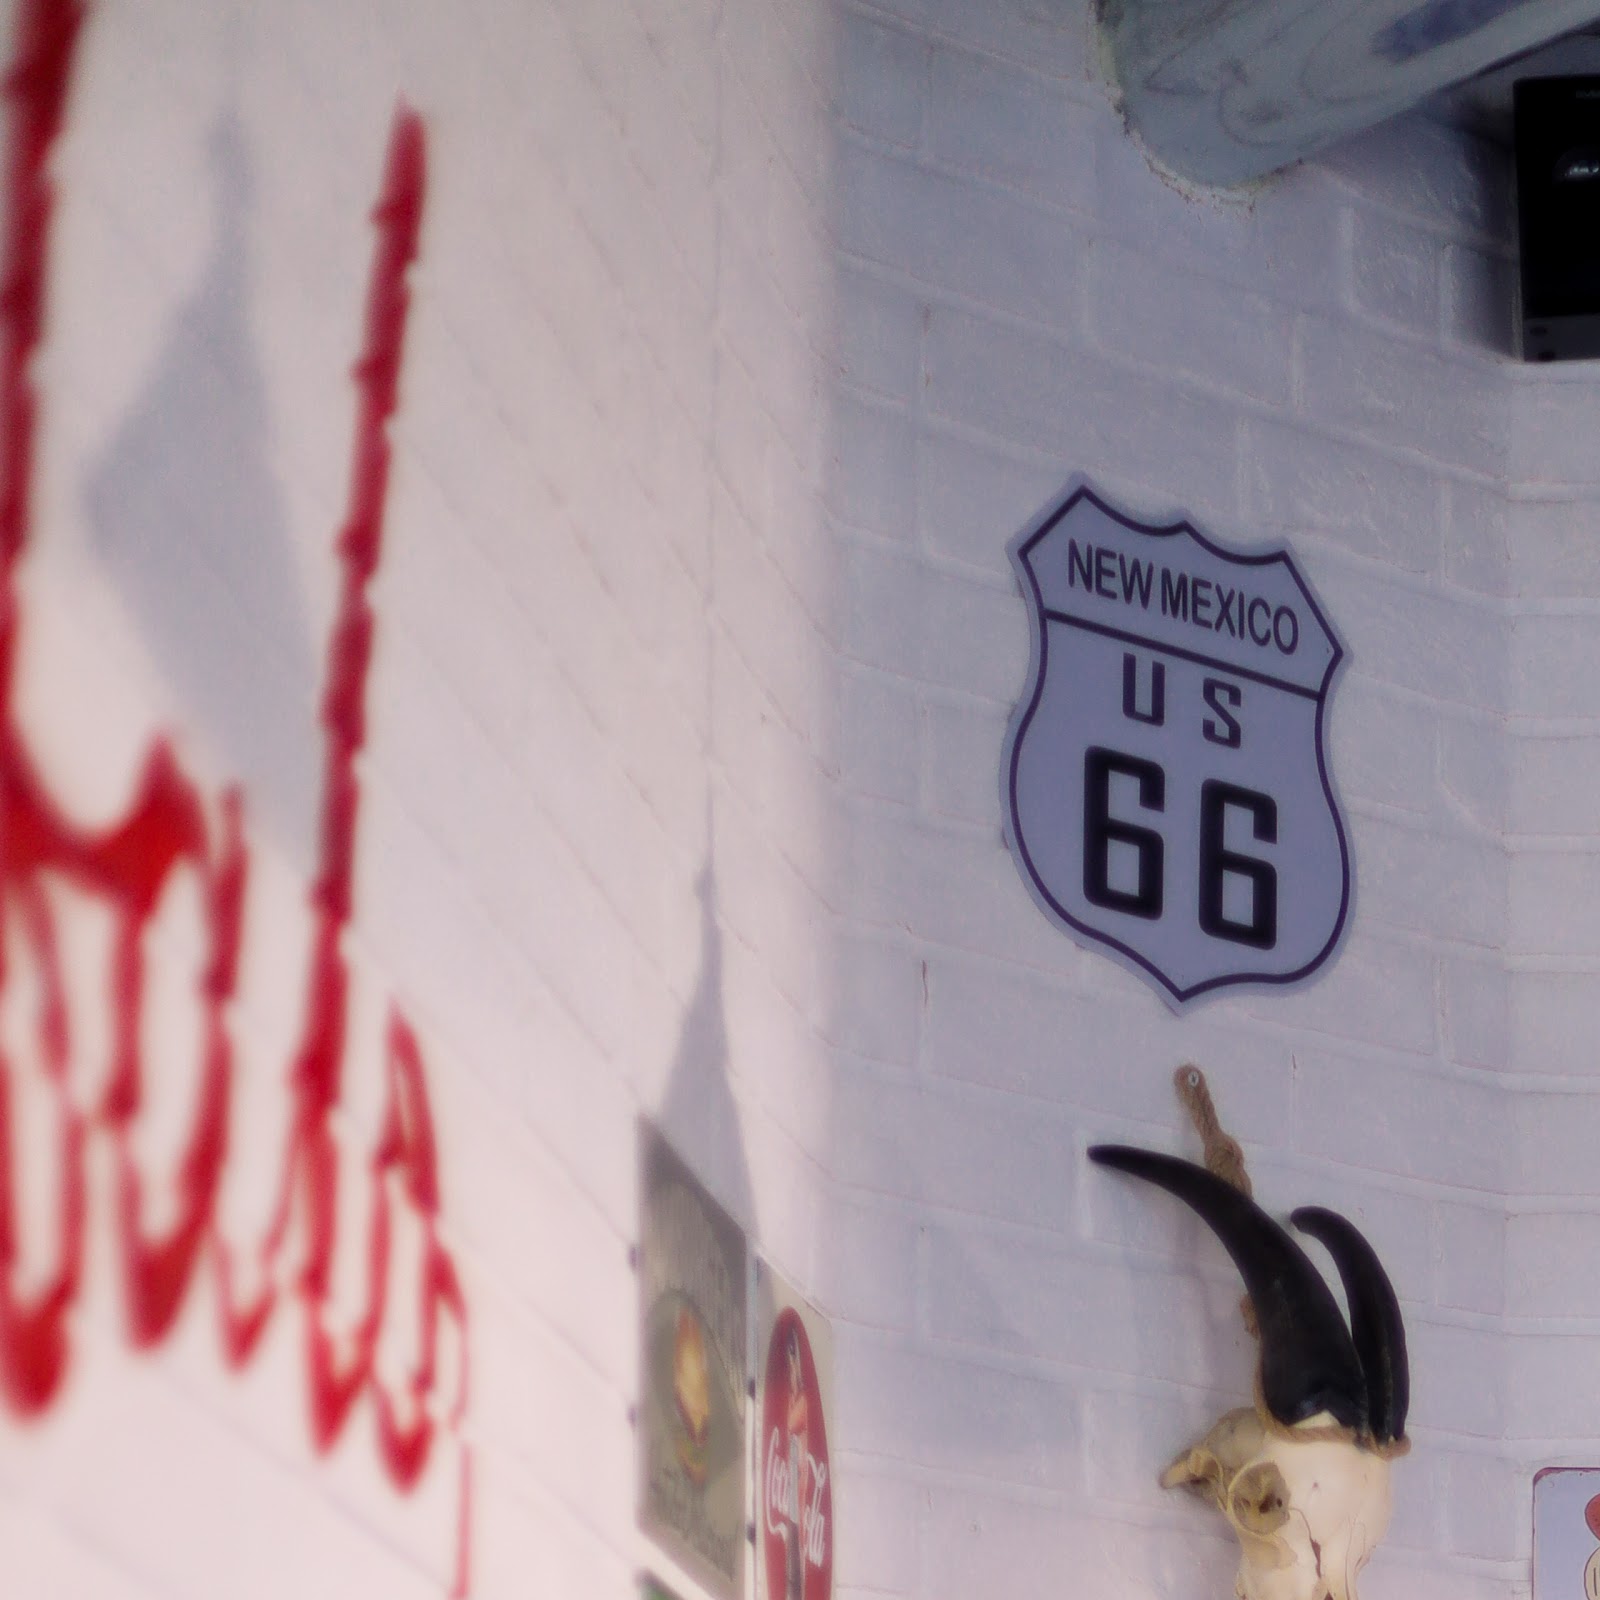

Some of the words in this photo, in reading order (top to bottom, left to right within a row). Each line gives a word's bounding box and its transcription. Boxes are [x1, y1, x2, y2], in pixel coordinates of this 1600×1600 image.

[1069, 538, 1153, 609] NEW
[1161, 567, 1299, 656] MEXICO
[1083, 745, 1278, 950] 66
